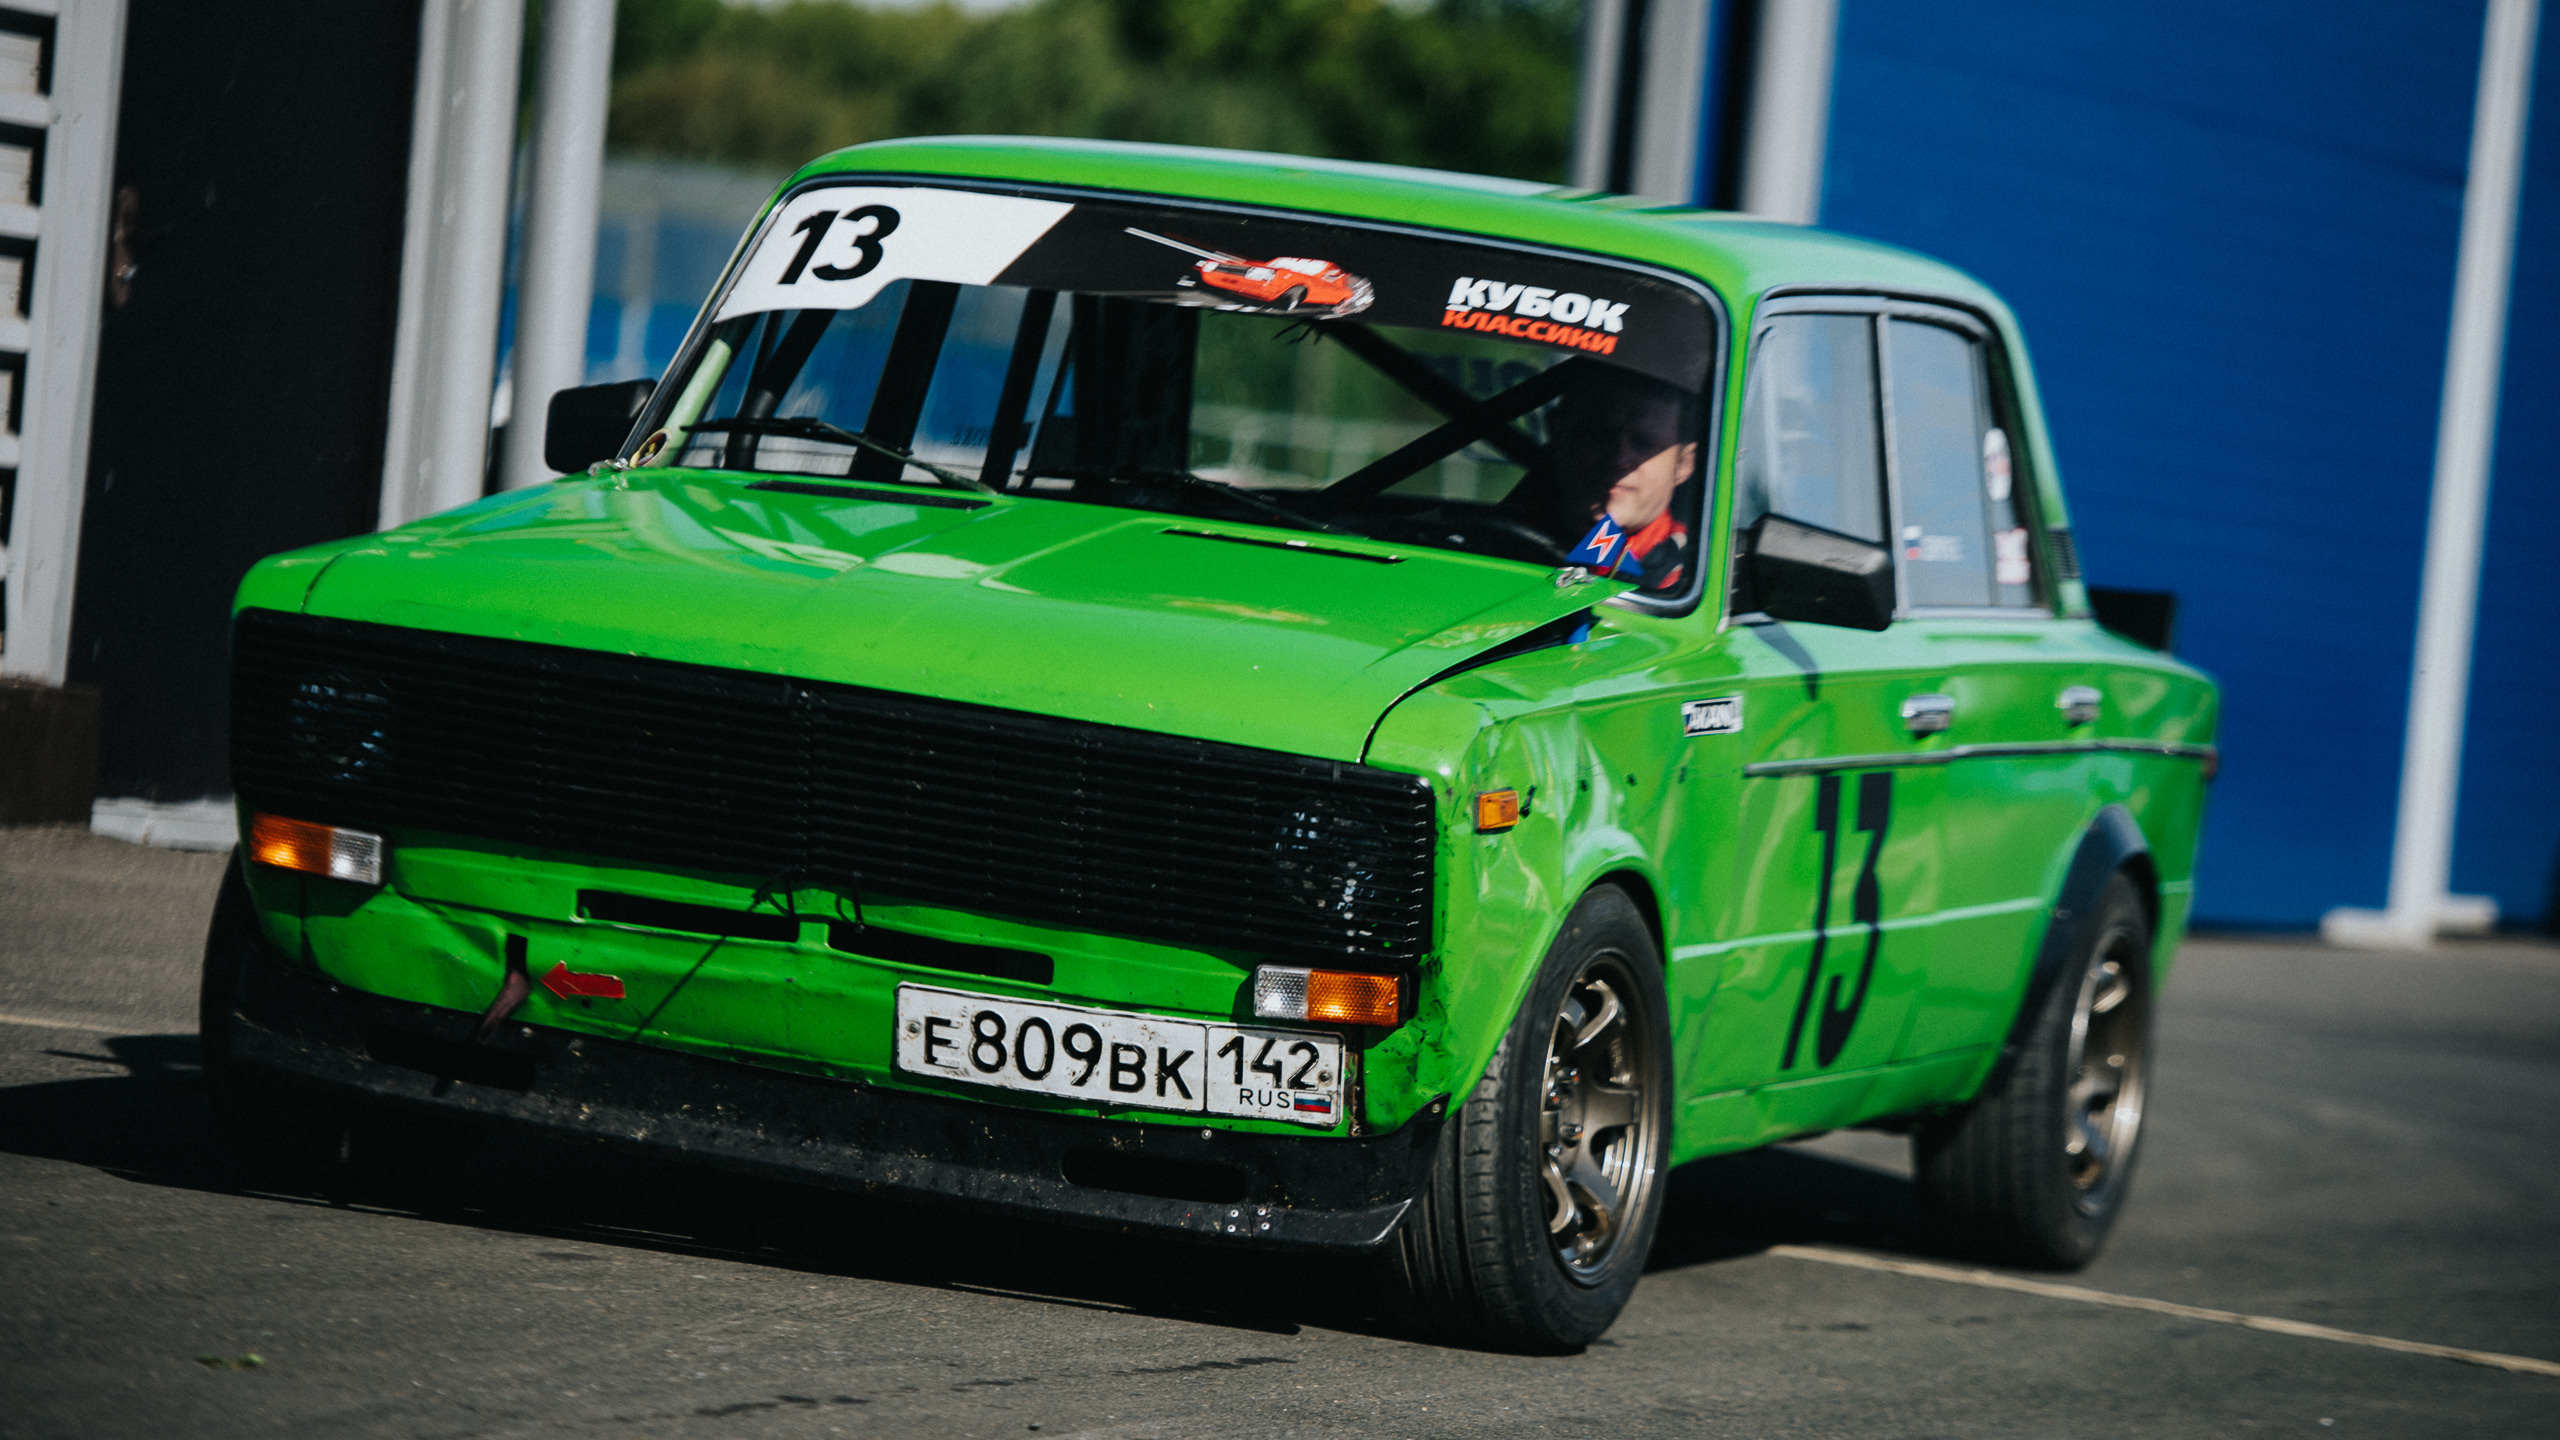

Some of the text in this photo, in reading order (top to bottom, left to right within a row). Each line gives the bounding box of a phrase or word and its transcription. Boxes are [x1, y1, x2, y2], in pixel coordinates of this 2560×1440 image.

[777, 205, 901, 285] 13
[1441, 310, 1619, 356] КЛАССИКИ
[1447, 276, 1631, 333] КУБОК
[1781, 772, 1893, 1070] 13
[924, 1010, 1319, 1100] Е809ВК 142
[1239, 1087, 1291, 1109] RUS
